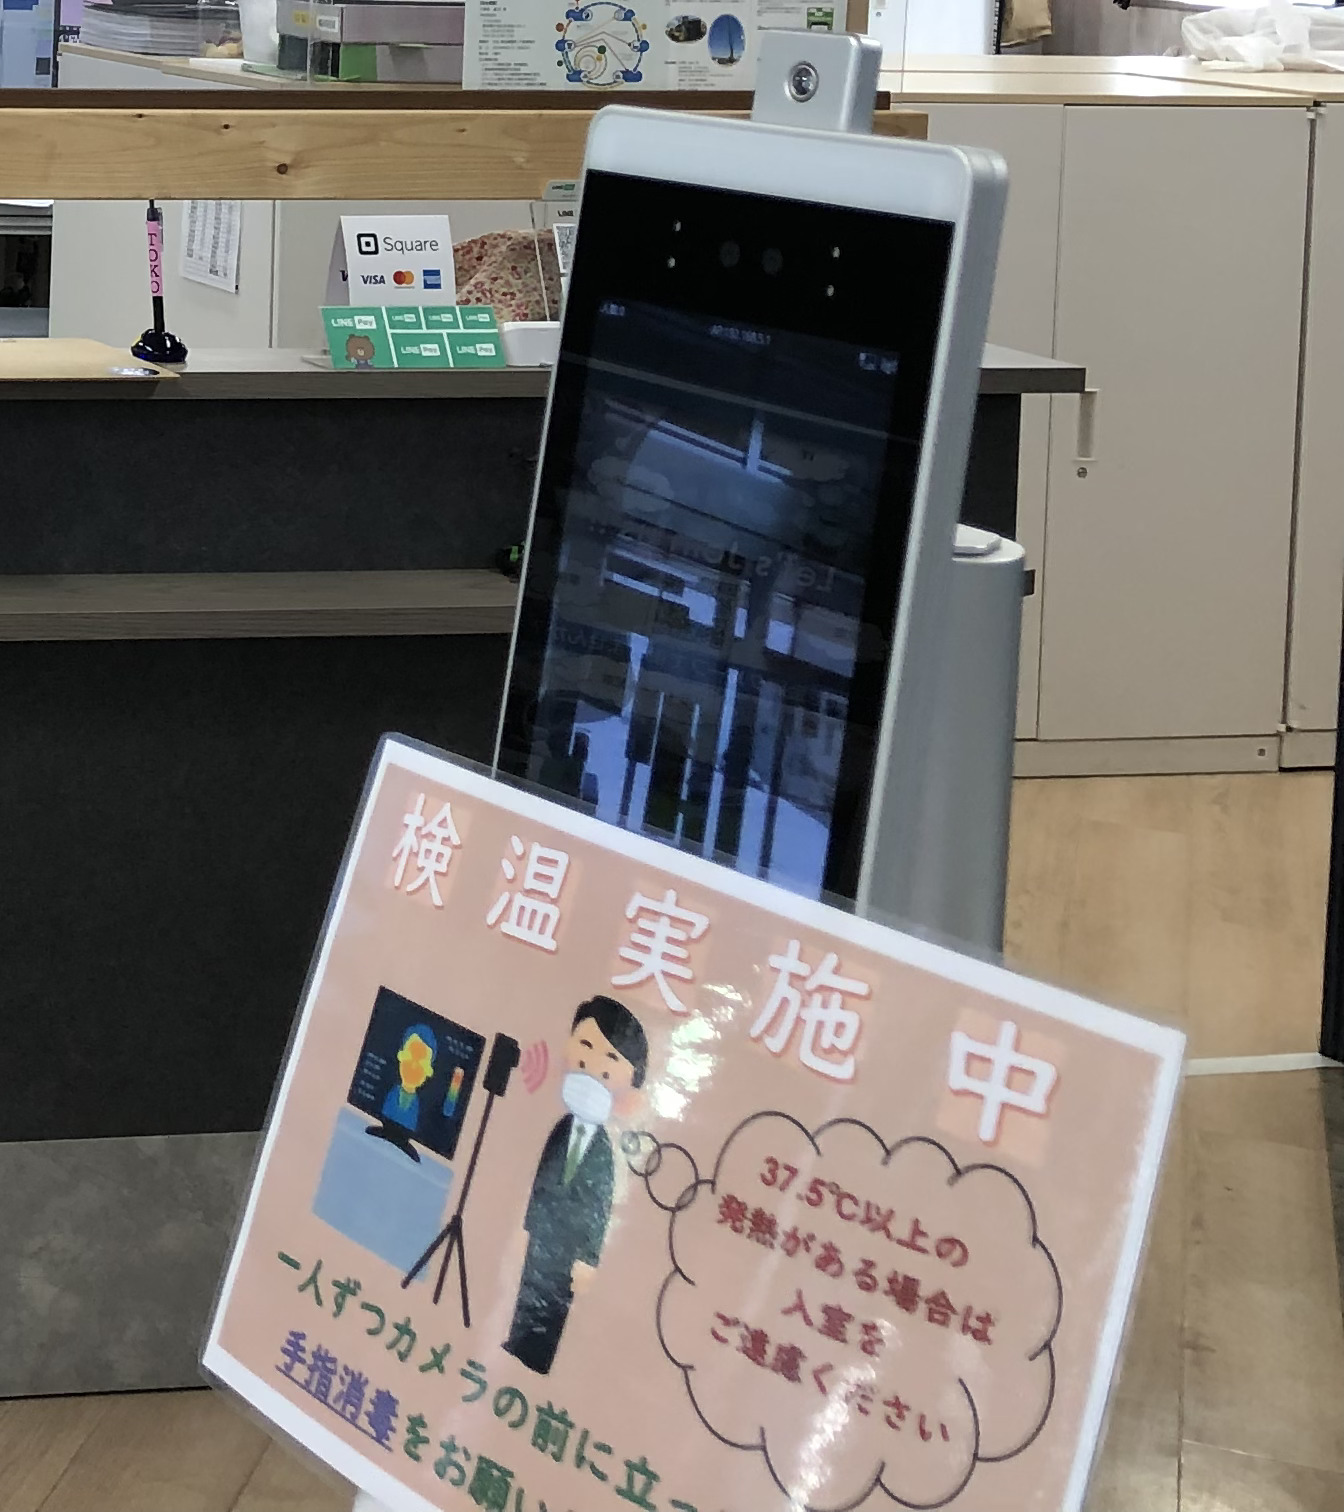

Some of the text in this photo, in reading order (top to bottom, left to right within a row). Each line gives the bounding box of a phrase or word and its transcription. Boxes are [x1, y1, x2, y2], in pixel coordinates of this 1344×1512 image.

[383, 237, 439, 252] Square
[361, 275, 386, 285] VISA
[331, 318, 374, 328] LINE Pay
[423, 346, 438, 355] Pay
[457, 346, 494, 355] LINE Pay
[714, 1192, 996, 1346] 発熱がある場合は
[780, 1288, 887, 1354] 入室を
